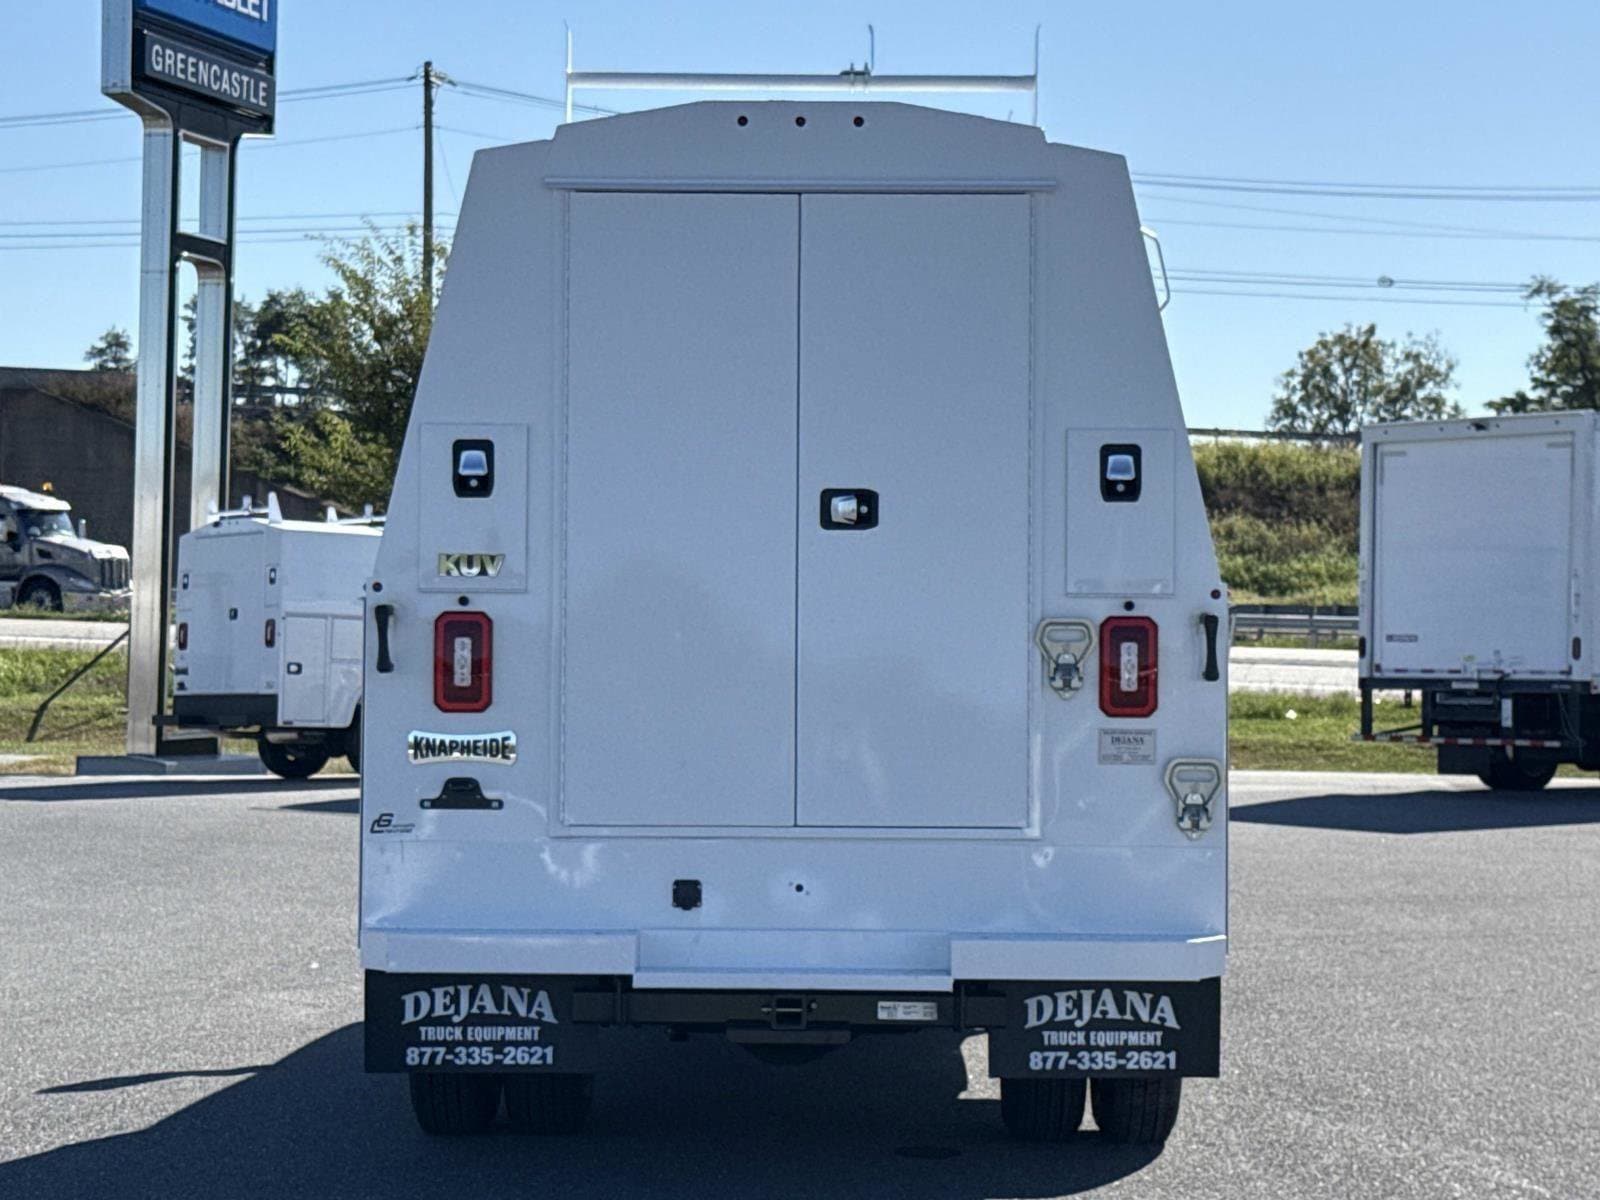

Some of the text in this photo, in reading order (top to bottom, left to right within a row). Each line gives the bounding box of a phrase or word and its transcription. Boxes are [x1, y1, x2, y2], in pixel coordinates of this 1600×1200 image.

[151, 44, 268, 107] GREENCASTLE
[438, 553, 506, 577] KUV
[413, 735, 511, 760] KNAPHEIDE
[401, 983, 558, 1025] DEJANA
[1024, 988, 1181, 1030] DEJANA
[419, 1026, 540, 1042] TRUCK EQUIPMENT
[1042, 1031, 1163, 1047] TRUCK EQUIPMENT
[406, 1046, 553, 1066] 877-335-2621
[1029, 1051, 1176, 1070] 877-335-2621
